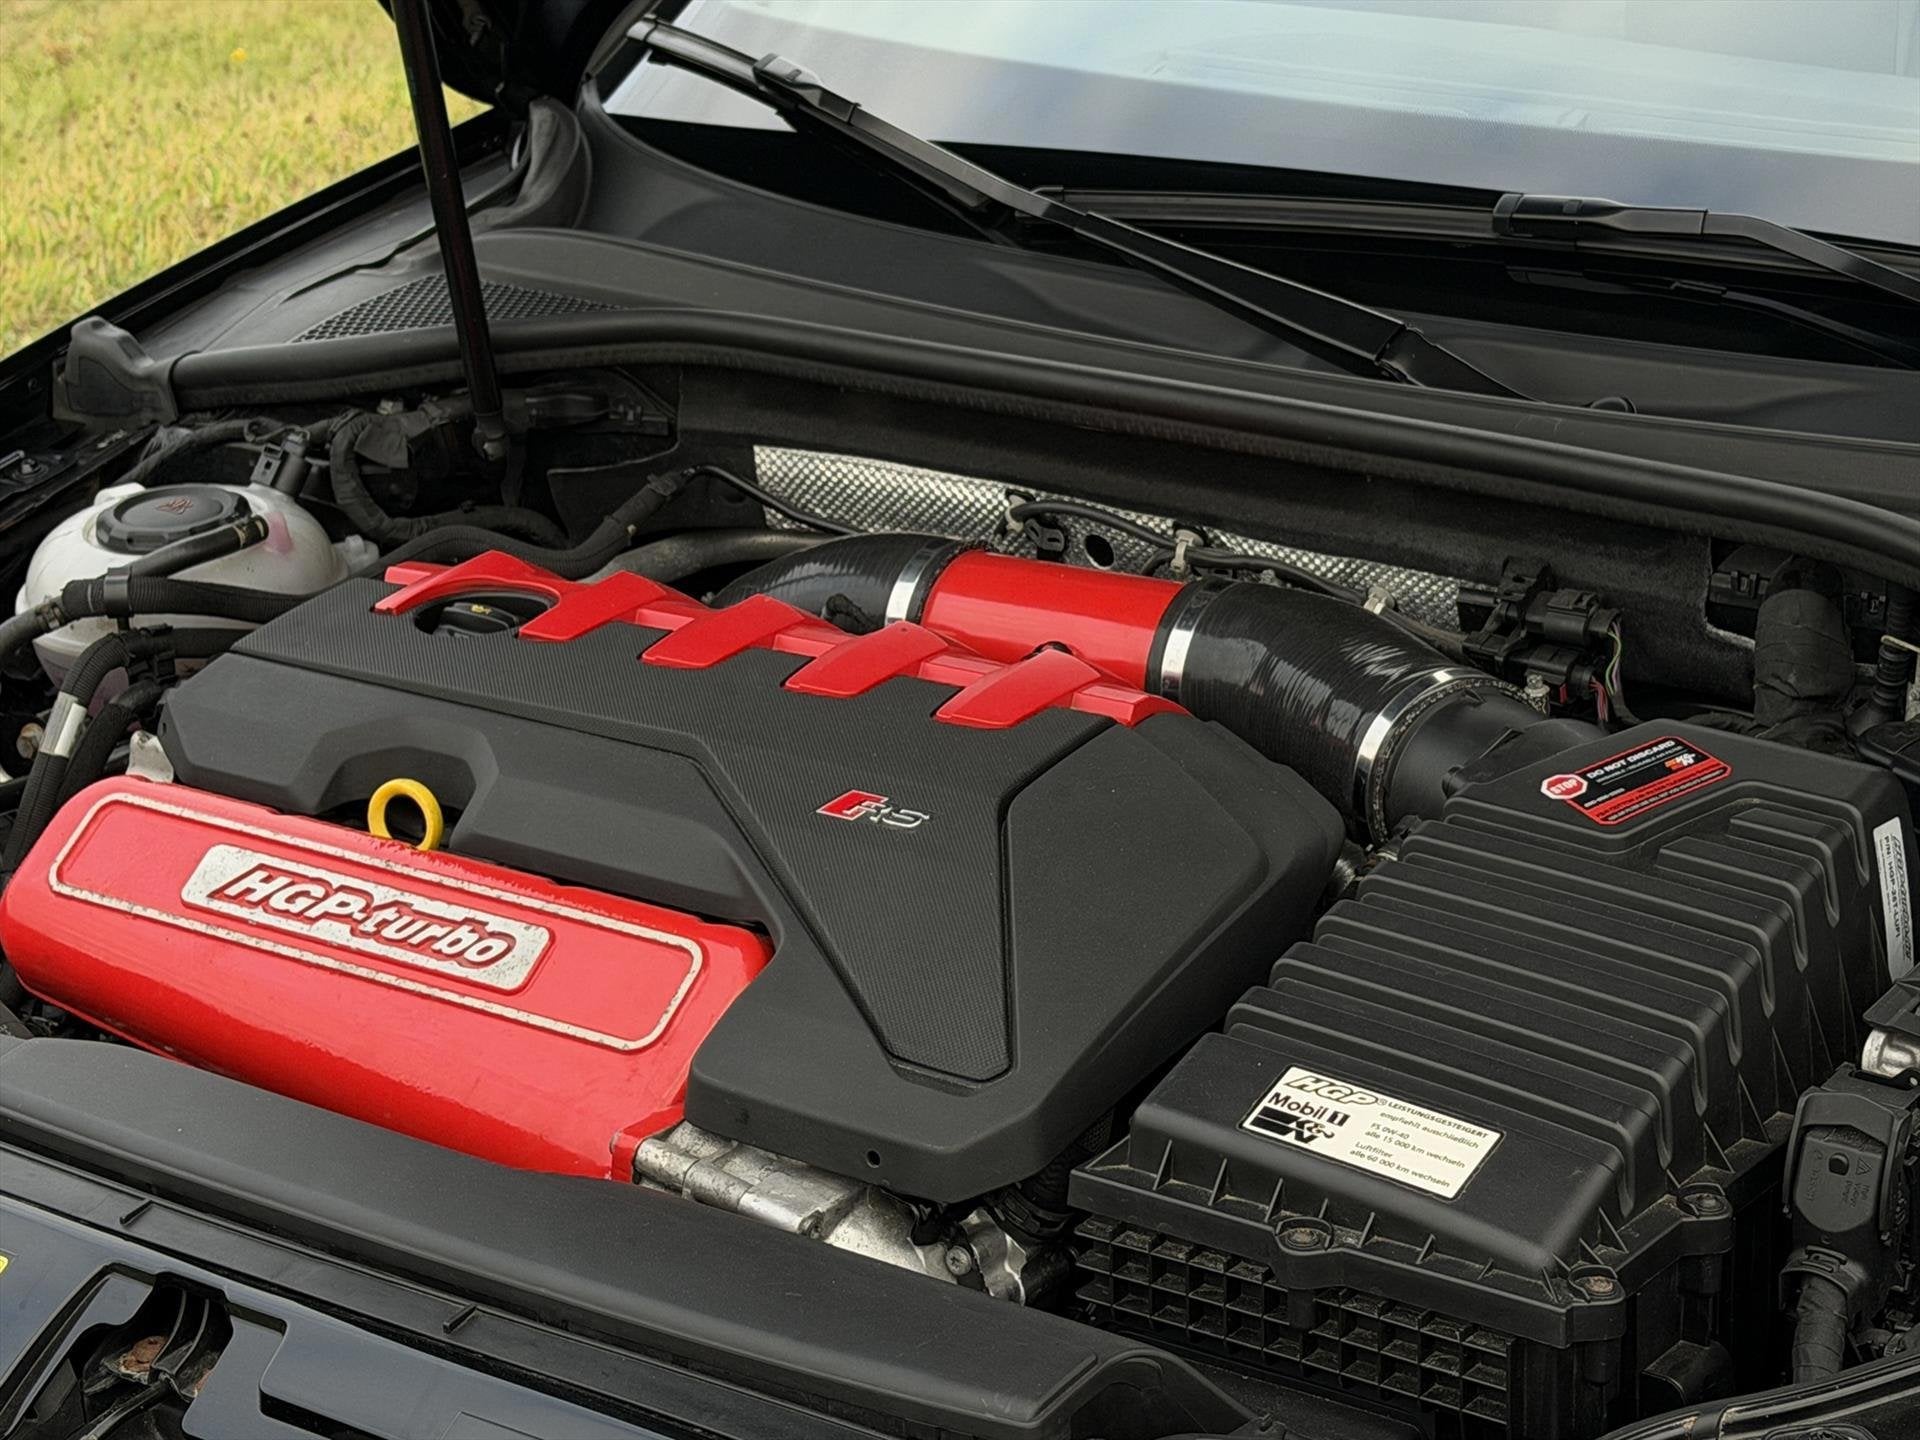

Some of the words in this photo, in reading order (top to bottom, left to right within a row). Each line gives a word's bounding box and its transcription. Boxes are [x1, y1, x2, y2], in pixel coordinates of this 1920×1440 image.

[1587, 770, 1604, 779] DO
[1604, 759, 1626, 773] NOT
[1627, 740, 1675, 762] DISCARD
[1550, 779, 1578, 794] STOP
[816, 789, 930, 828] RS
[1268, 1092, 1328, 1119] Mobil
[1327, 1111, 1350, 1126] 1
[1283, 1075, 1379, 1105] HGP
[1389, 1101, 1489, 1138] LEISTUNGSGESTEIGERT
[1380, 1112, 1421, 1129] empfiehlt
[1365, 1130, 1381, 1139] alle
[1394, 1139, 1411, 1149] 000
[1411, 1145, 1425, 1154] km
[1426, 1152, 1466, 1168] wechseln
[1350, 1150, 1365, 1158] alle
[1379, 1158, 1395, 1168] 000
[1396, 1163, 1410, 1173] km
[1411, 1170, 1450, 1188] wechseln
